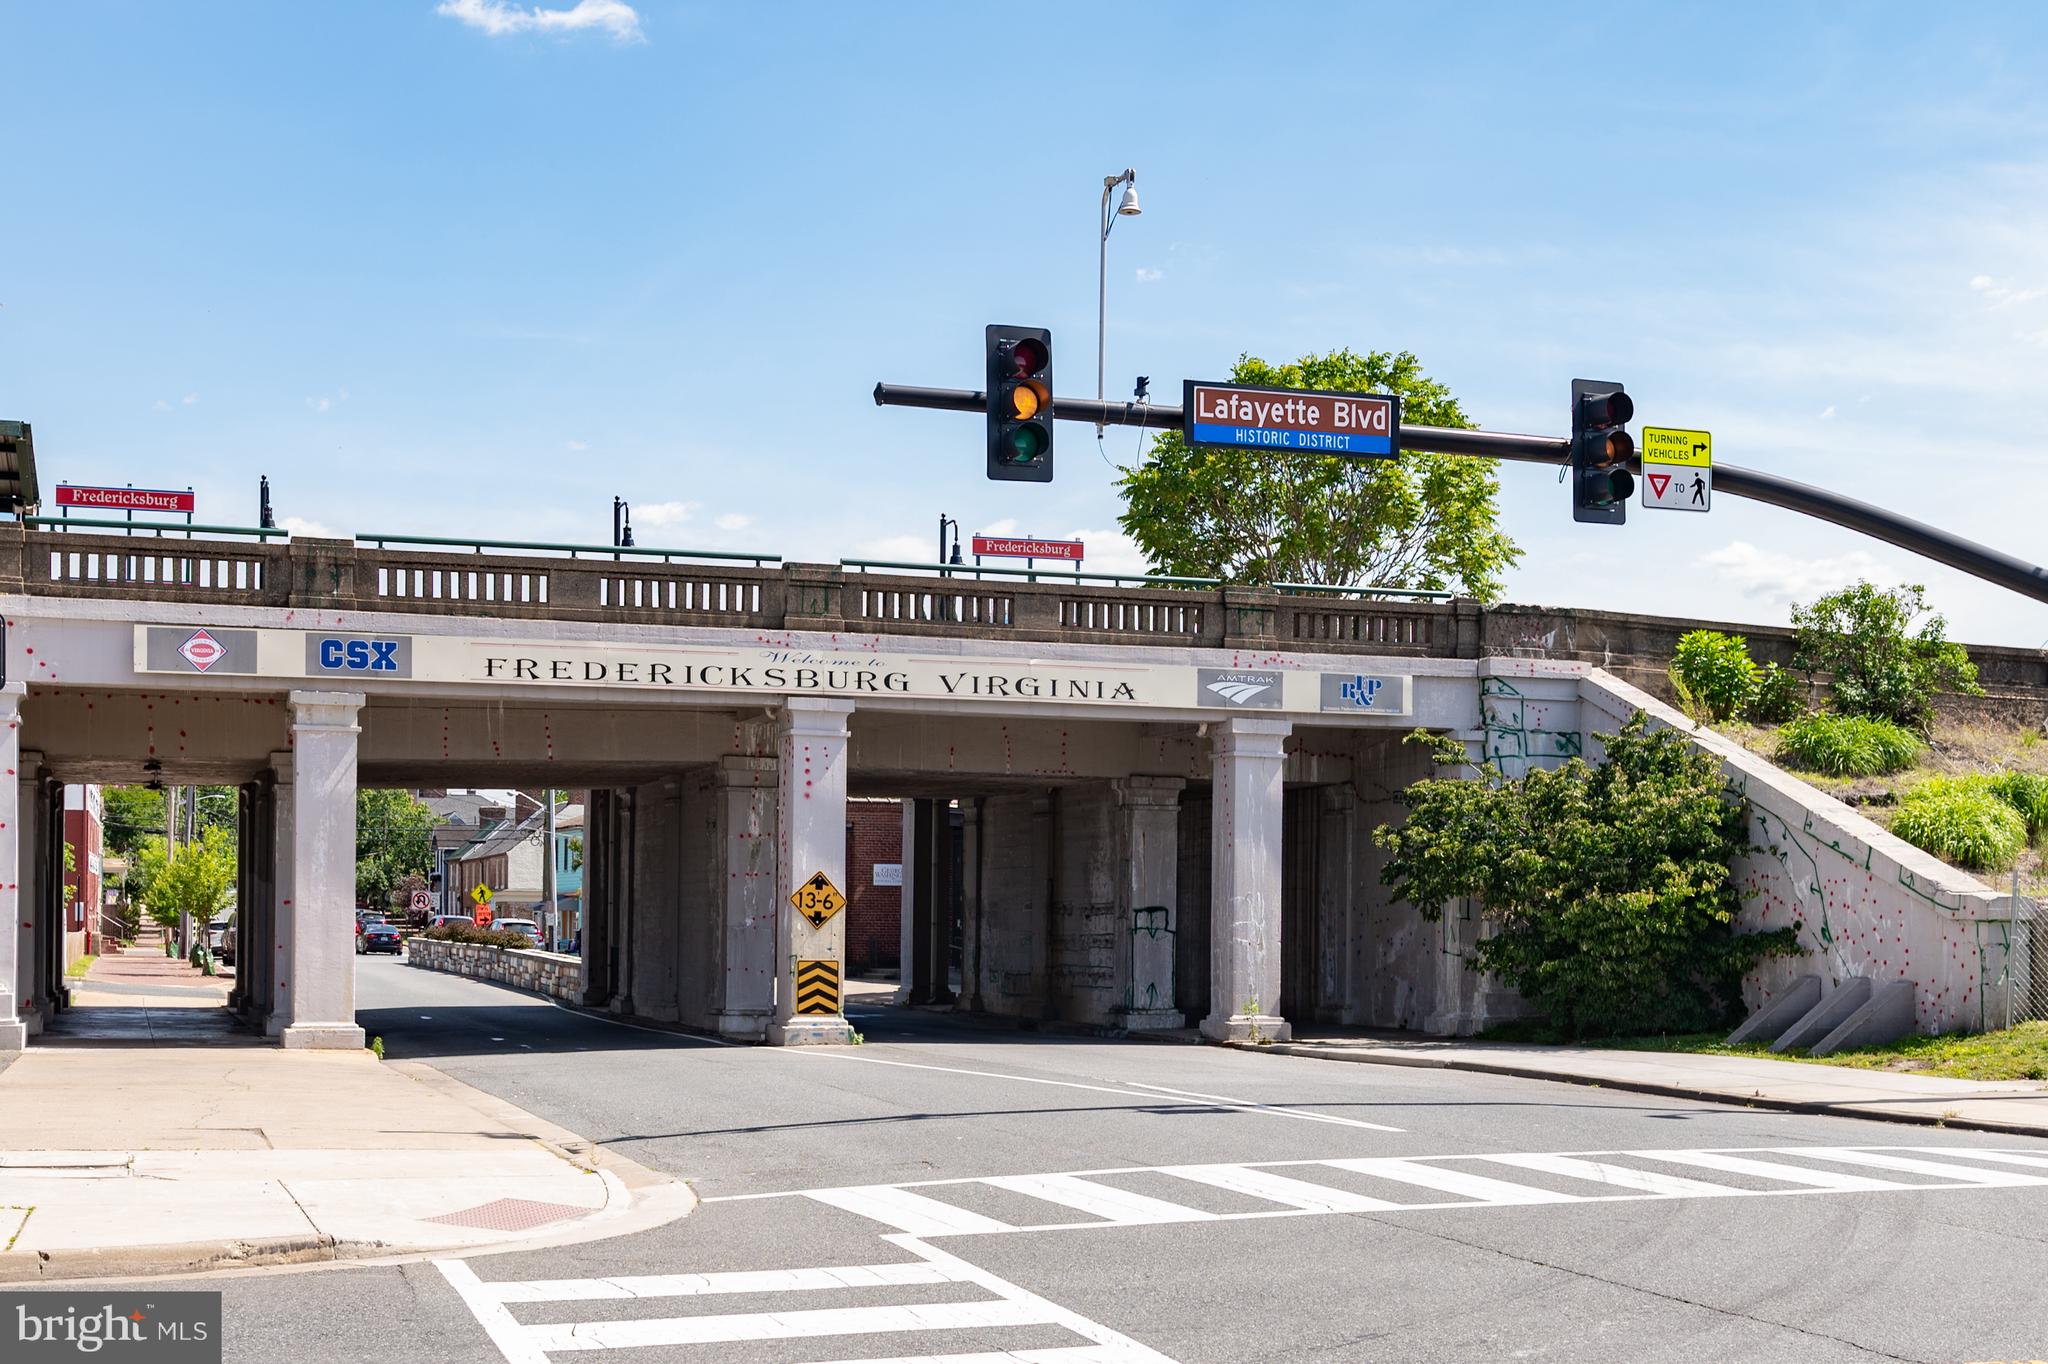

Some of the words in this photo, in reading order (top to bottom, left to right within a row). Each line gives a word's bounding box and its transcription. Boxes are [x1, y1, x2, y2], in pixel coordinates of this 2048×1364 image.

[1199, 391, 1320, 428] Lafayette
[1334, 402, 1386, 430] Blvd
[1235, 428, 1290, 446] HISTORIC
[1299, 433, 1351, 449] DISTRICT
[1649, 433, 1688, 446] TURNING
[1647, 448, 1690, 460] VEHICLES
[1674, 482, 1685, 494] TO
[72, 489, 178, 510] Fredericksburg
[985, 540, 1071, 558] Fredericksburg
[320, 638, 398, 671] CSX
[759, 651, 861, 666] Welcome
[868, 658, 888, 667] to
[484, 657, 910, 693] FREDERICKSBURG
[938, 671, 1136, 700] VIRGINIA
[1216, 674, 1275, 684] AMTRAK
